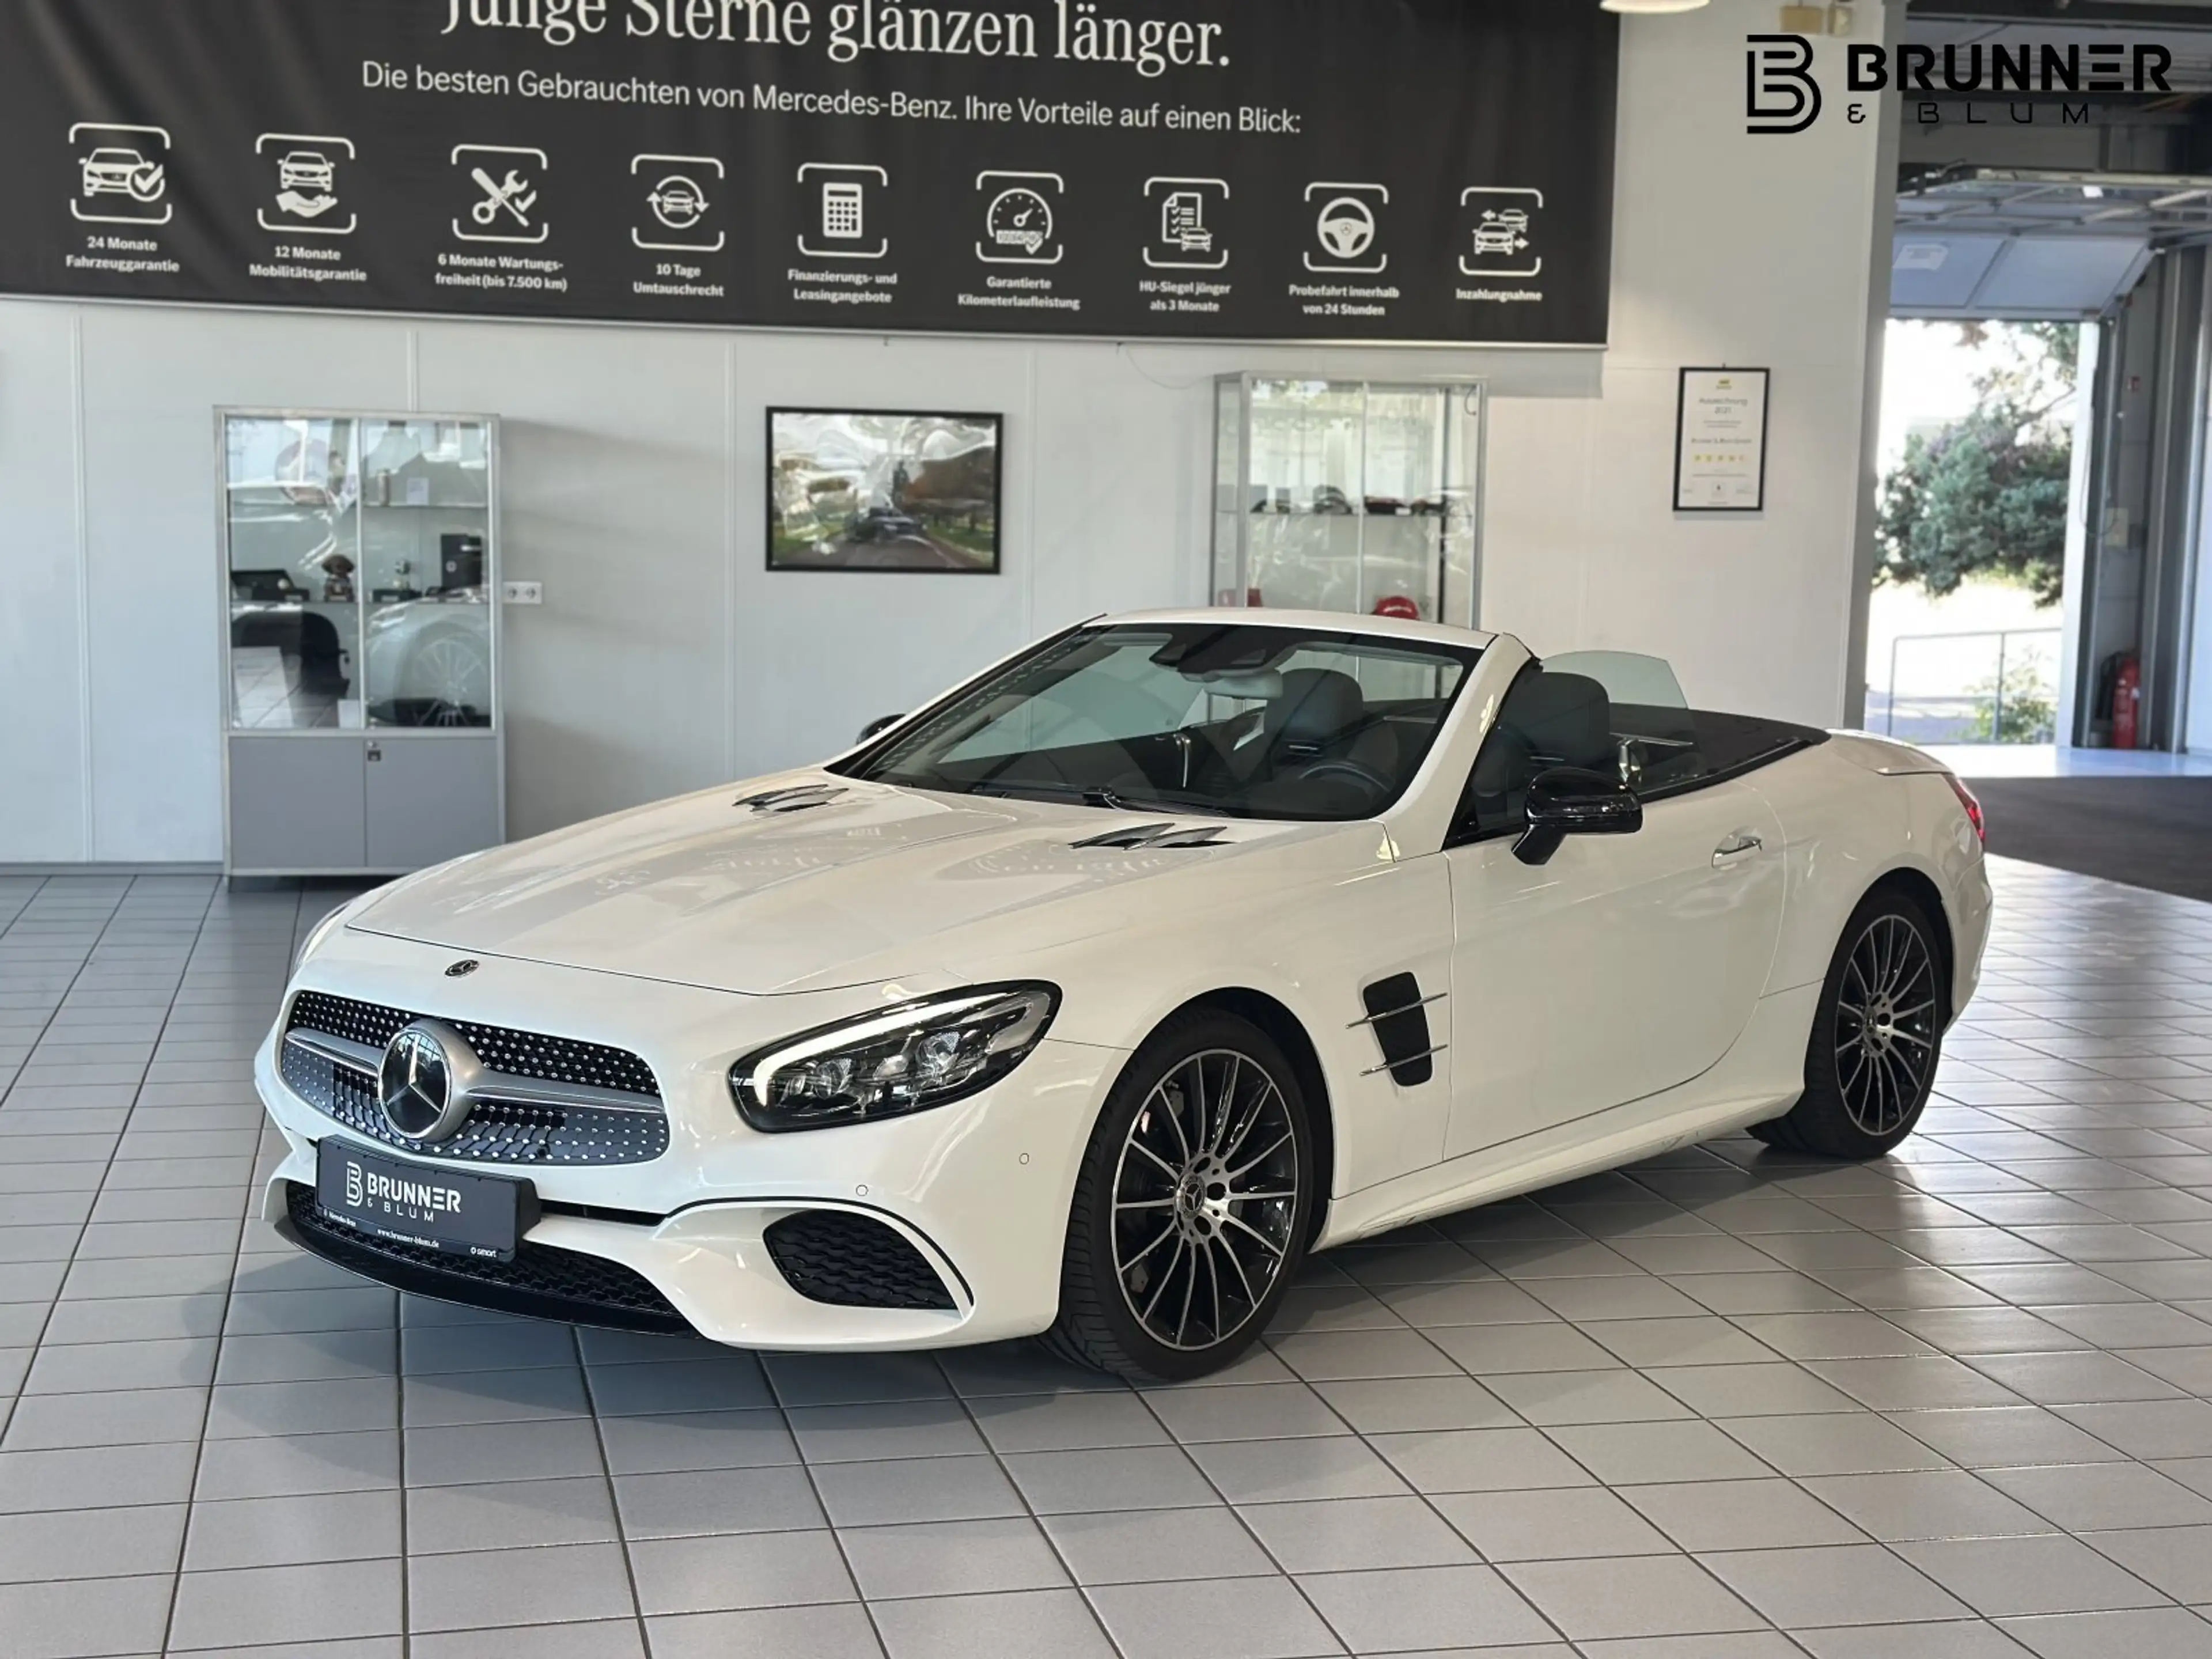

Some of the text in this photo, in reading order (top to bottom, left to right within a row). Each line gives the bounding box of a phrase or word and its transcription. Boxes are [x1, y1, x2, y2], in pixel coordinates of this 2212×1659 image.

[626, 0, 811, 46] Sterne
[827, 0, 1038, 63] glänzen
[1054, 0, 1229, 77] länger.
[363, 60, 1301, 133] Die besten Gebrauchten von Mercedes-Benz. Ihre Vorteile auf einen Blick:
[87, 236, 158, 251] 24 Monate
[275, 245, 341, 261] 12 Monate
[66, 254, 180, 272] Fahrzeuggarantie
[437, 253, 563, 272] 6 Monate Wartungs-
[249, 263, 367, 282] Mobilitätsgarantie
[656, 263, 701, 279] 10 Tage
[787, 268, 897, 286] Finanzierungs- und
[435, 272, 567, 293] freiheit (bis 7.500 km)
[633, 281, 724, 297] Umtauschrecht
[986, 276, 1052, 289] Garantierte
[1139, 281, 1231, 296] HU-Siegel jünger
[793, 288, 892, 304] Leasingangebote
[1289, 284, 1400, 298] Probefahrt innerhalb
[1456, 288, 1543, 303] Inzahlungnahme
[958, 294, 1080, 310] Kilometerlaufleistung
[1150, 300, 1220, 312] als 3 Monate
[1302, 303, 1385, 316] von 24 Stunden
[367, 1172, 461, 1213] BRUNNER
[384, 1201, 434, 1223] BLUM
[476, 1248, 497, 1257] smart
